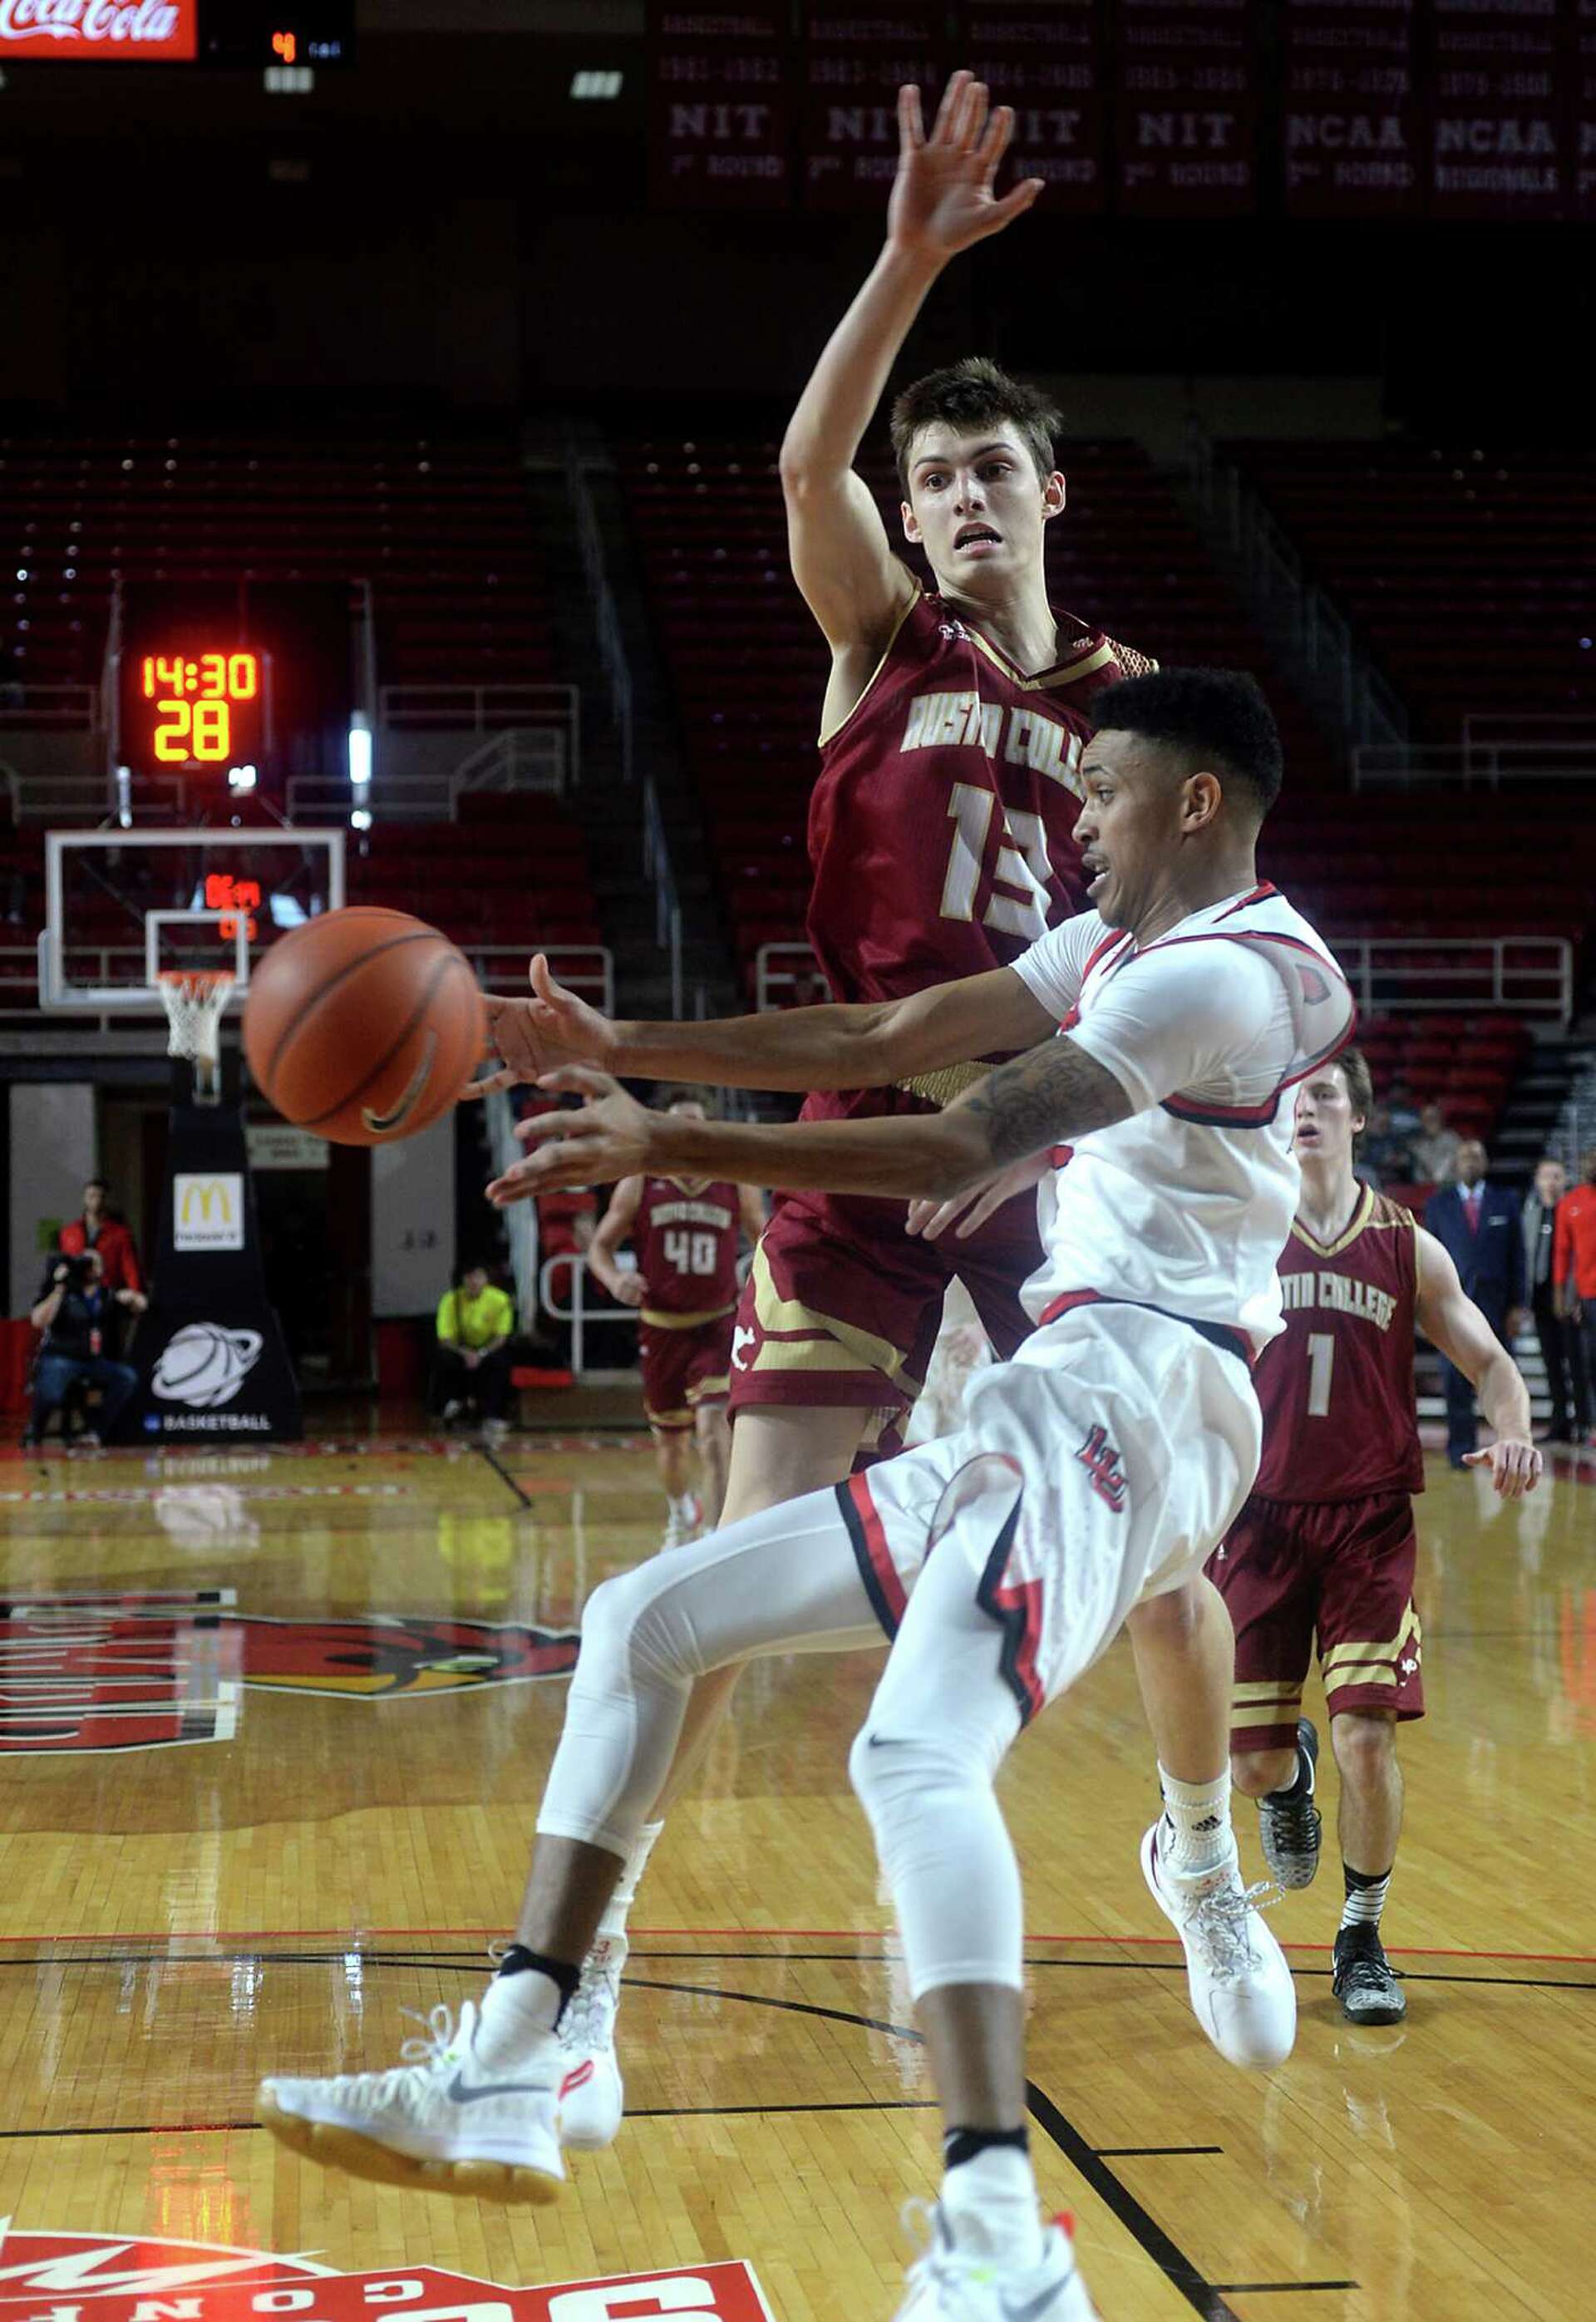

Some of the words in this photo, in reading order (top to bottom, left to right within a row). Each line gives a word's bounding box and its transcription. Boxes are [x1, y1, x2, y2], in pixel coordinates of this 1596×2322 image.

[669, 103, 770, 138] NIT
[828, 106, 899, 141] NI
[1011, 108, 1082, 145] IT
[1137, 111, 1236, 147] NIT
[1287, 114, 1407, 150] NCAA
[1436, 118, 1557, 154] NCAA
[143, 653, 257, 700] 14:30
[154, 699, 231, 762] 28
[939, 781, 1056, 942] 13
[663, 1230, 717, 1276] 40
[1307, 1333, 1334, 1417] 1
[163, 1415, 271, 1431] BASKETBALL
